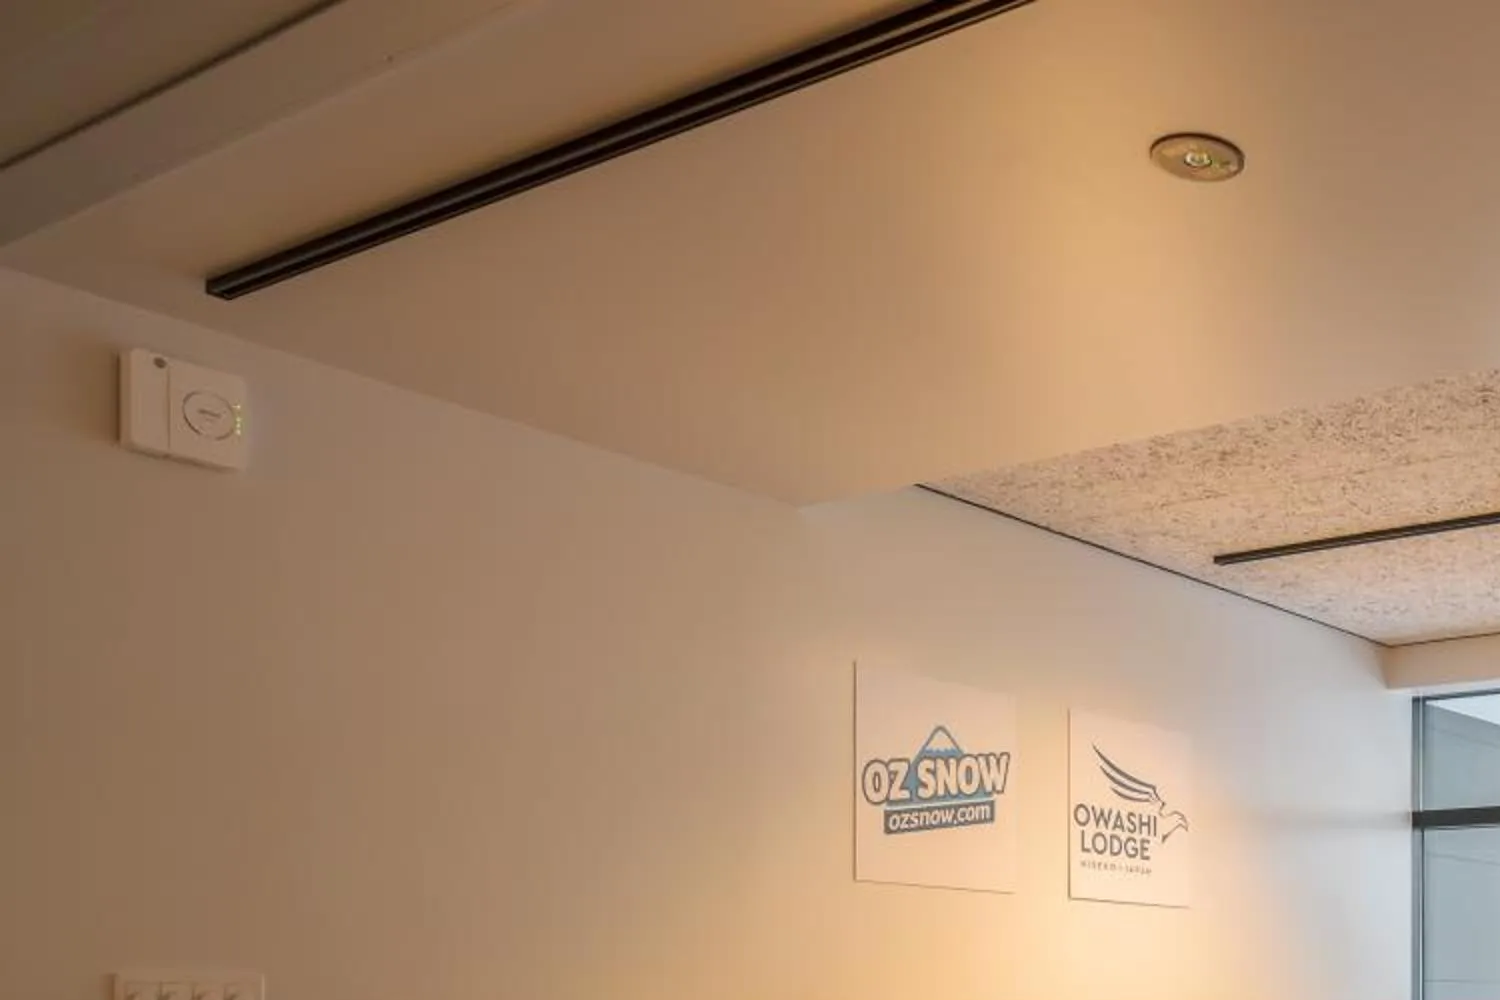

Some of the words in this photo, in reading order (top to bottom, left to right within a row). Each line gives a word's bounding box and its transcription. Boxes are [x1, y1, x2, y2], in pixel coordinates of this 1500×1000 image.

[862, 757, 912, 805] OZ
[915, 752, 1010, 801] SNOW
[888, 804, 991, 831] ozsnow.com
[1073, 803, 1157, 837] OWASHI
[1080, 830, 1151, 860] LODGE
